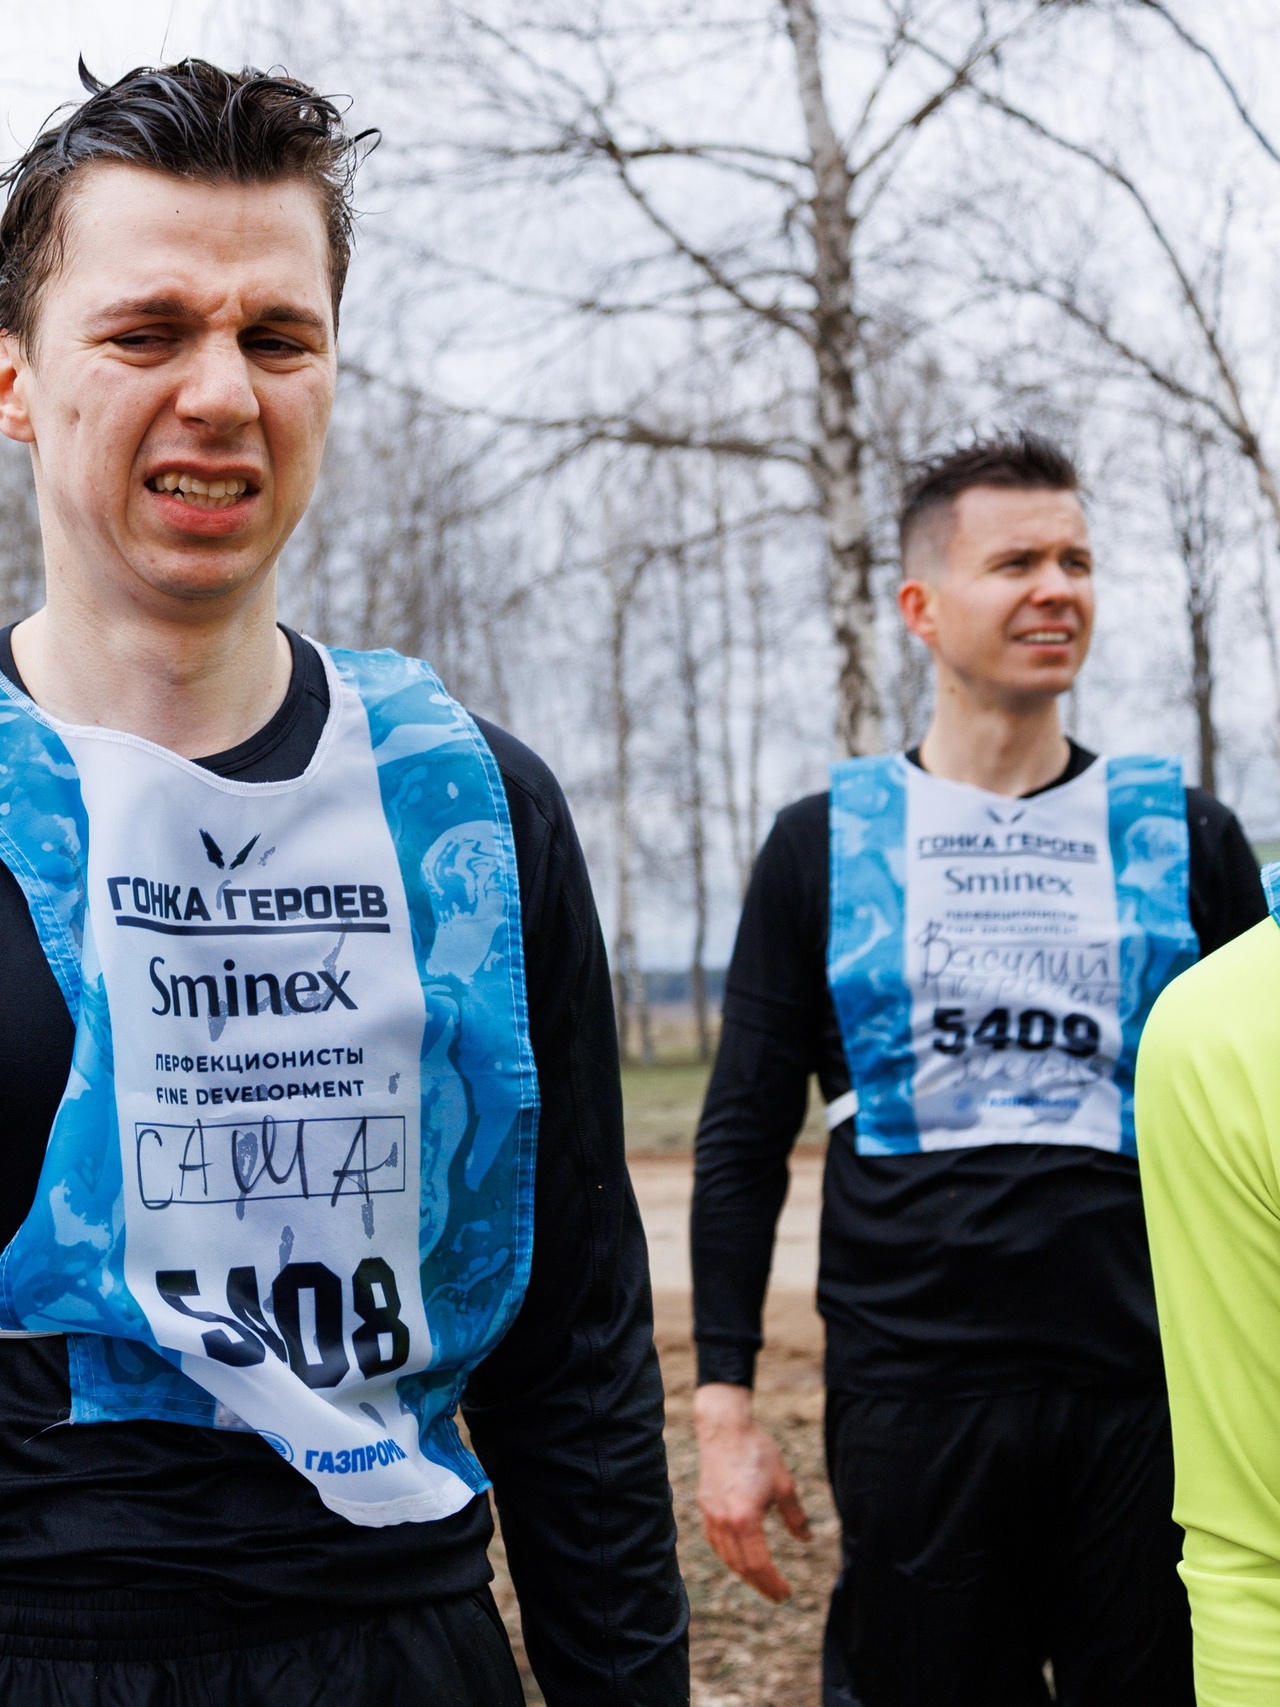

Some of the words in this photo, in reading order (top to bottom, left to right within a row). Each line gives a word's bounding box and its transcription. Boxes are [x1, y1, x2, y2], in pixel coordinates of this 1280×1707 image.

[919, 834, 997, 850] ГОНКА
[1006, 832, 1097, 855] ГЕРОЕВ
[107, 876, 212, 921] ГОНКА
[222, 884, 389, 921] ГЕРОЕВ
[944, 866, 1074, 896] Sminex
[149, 956, 359, 1018] Sminex
[933, 1007, 1100, 1058] 5409
[155, 1047, 364, 1074] ПЕРФЕКЦИОНИСТЫ
[156, 1086, 189, 1105] FINE
[196, 1079, 365, 1106] DEVELOPMENT
[156, 1257, 410, 1389] 5408
